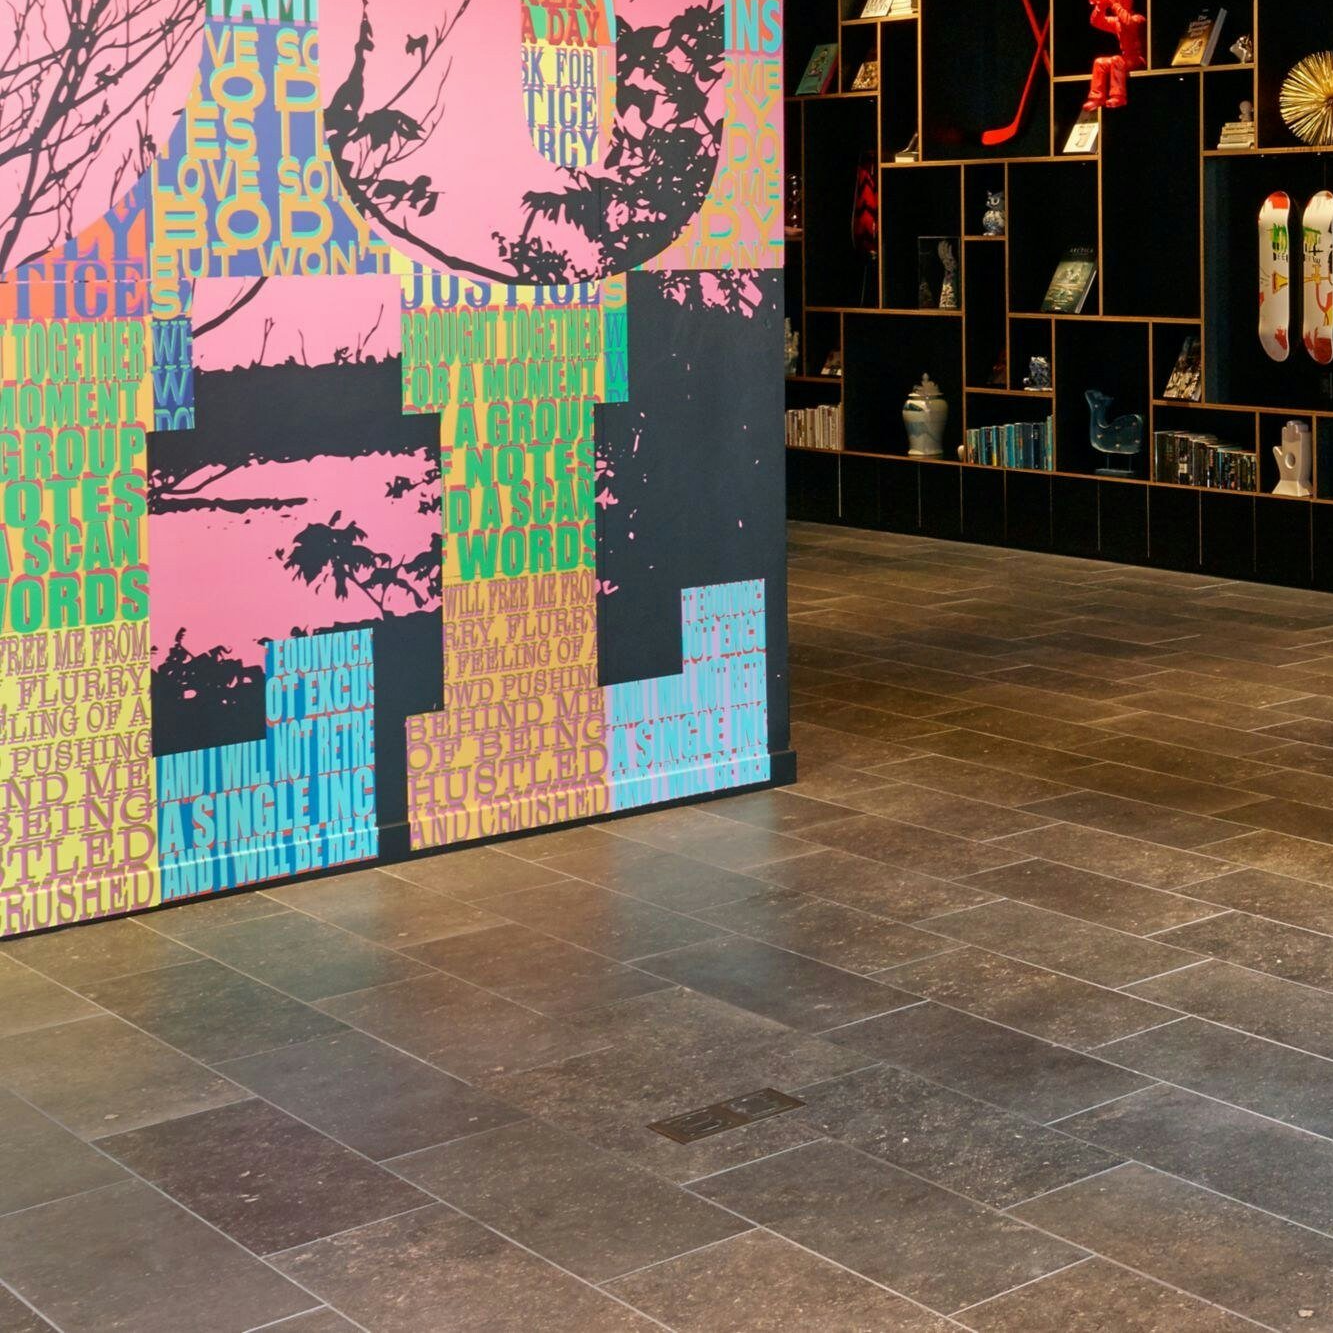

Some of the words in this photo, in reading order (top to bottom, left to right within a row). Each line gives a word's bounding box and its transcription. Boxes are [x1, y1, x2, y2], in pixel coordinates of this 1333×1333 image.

[546, 7, 601, 49] DAY
[556, 46, 595, 90] FOR
[150, 155, 262, 202] LOVE
[12, 317, 147, 385] TOGETHER
[400, 304, 500, 367] BROUGHT
[502, 301, 601, 363] TOGETHER
[456, 360, 478, 407] A
[482, 356, 597, 404] MOMENT
[453, 402, 479, 449] A
[479, 481, 504, 532] A
[487, 573, 531, 614] FREE
[532, 571, 558, 609] ME
[53, 628, 86, 672] ME
[90, 620, 150, 669] FROM
[455, 639, 551, 679] FEELING
[556, 634, 585, 667] OF
[86, 698, 122, 735] OF
[130, 693, 150, 730] A
[405, 695, 546, 747] BEHIND
[552, 685, 606, 723] ME
[10, 729, 153, 780] PUSHING
[160, 750, 204, 805] AND
[220, 738, 272, 795] WILL
[272, 719, 313, 783] NOT
[406, 737, 463, 775] OF
[475, 713, 608, 764] BEING
[83, 760, 150, 802] ME
[407, 743, 610, 812] HUSTLED
[160, 800, 188, 860] A
[191, 778, 312, 851] SINGLE
[409, 805, 471, 852] AND
[476, 775, 610, 837] CRUSHED
[163, 846, 216, 903] AND
[231, 831, 291, 887] WILL
